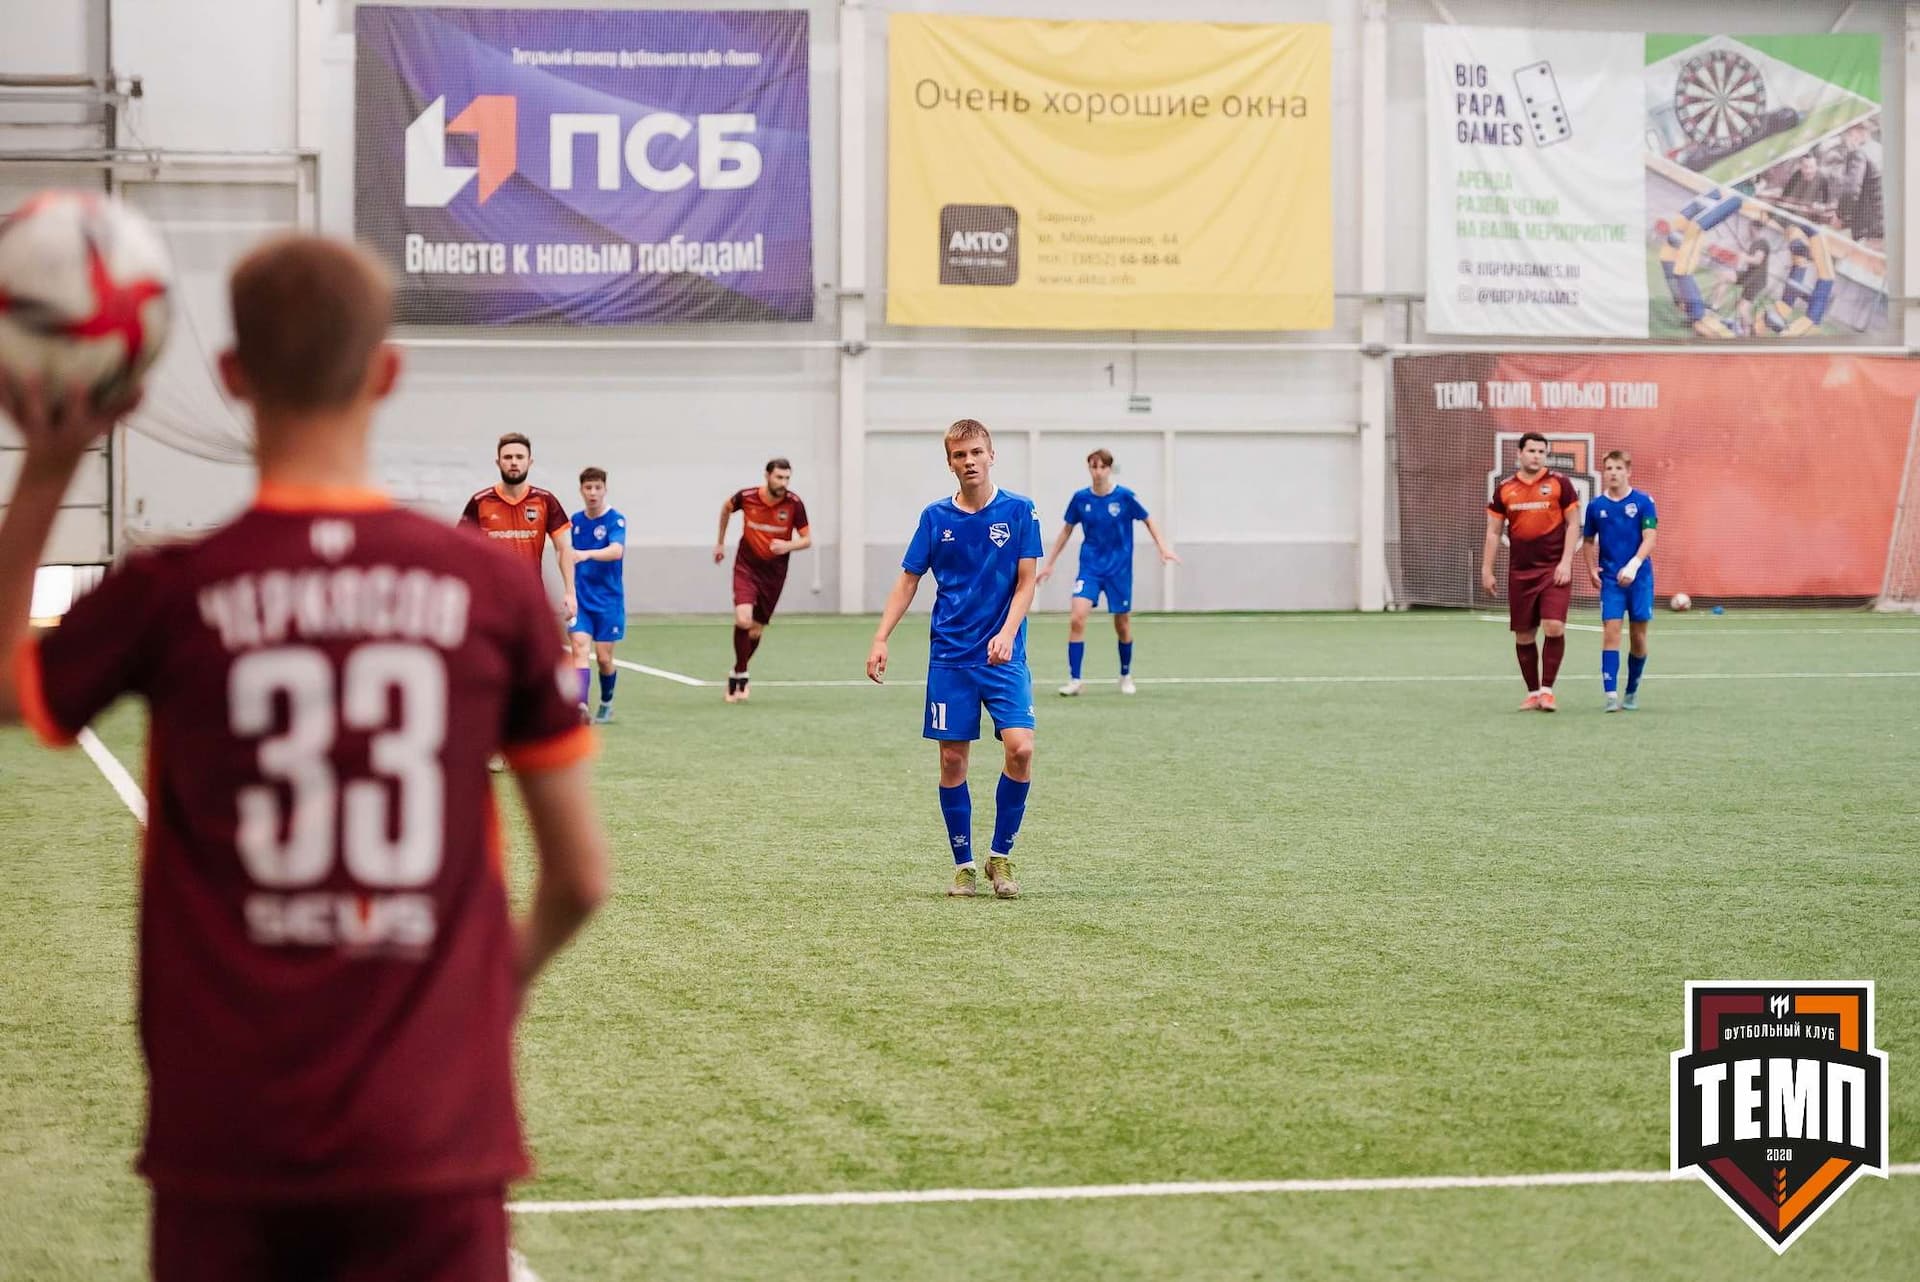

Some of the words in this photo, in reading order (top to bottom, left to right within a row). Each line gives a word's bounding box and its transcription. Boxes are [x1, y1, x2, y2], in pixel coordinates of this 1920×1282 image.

[1456, 64, 1488, 88] BIG
[915, 78, 1031, 113] Очень
[1042, 91, 1209, 122] хорошие
[1221, 94, 1308, 118] окна
[1457, 93, 1506, 117] PAPA
[1457, 121, 1523, 146] GAMES
[550, 112, 762, 192] ПСБ
[405, 234, 506, 274] Вместе
[513, 245, 530, 274] к
[537, 245, 631, 274] новым
[638, 233, 763, 276] победам!
[949, 231, 1009, 253] АКТО
[1104, 362, 1114, 388] 1
[1434, 381, 1483, 410] ТЕМП,
[1487, 382, 1536, 410] ТЕМП,
[1541, 382, 1605, 409] ТОЛЬКО
[1610, 382, 1658, 409] ТЕМП!
[931, 702, 948, 730] 21
[228, 642, 449, 890] 33
